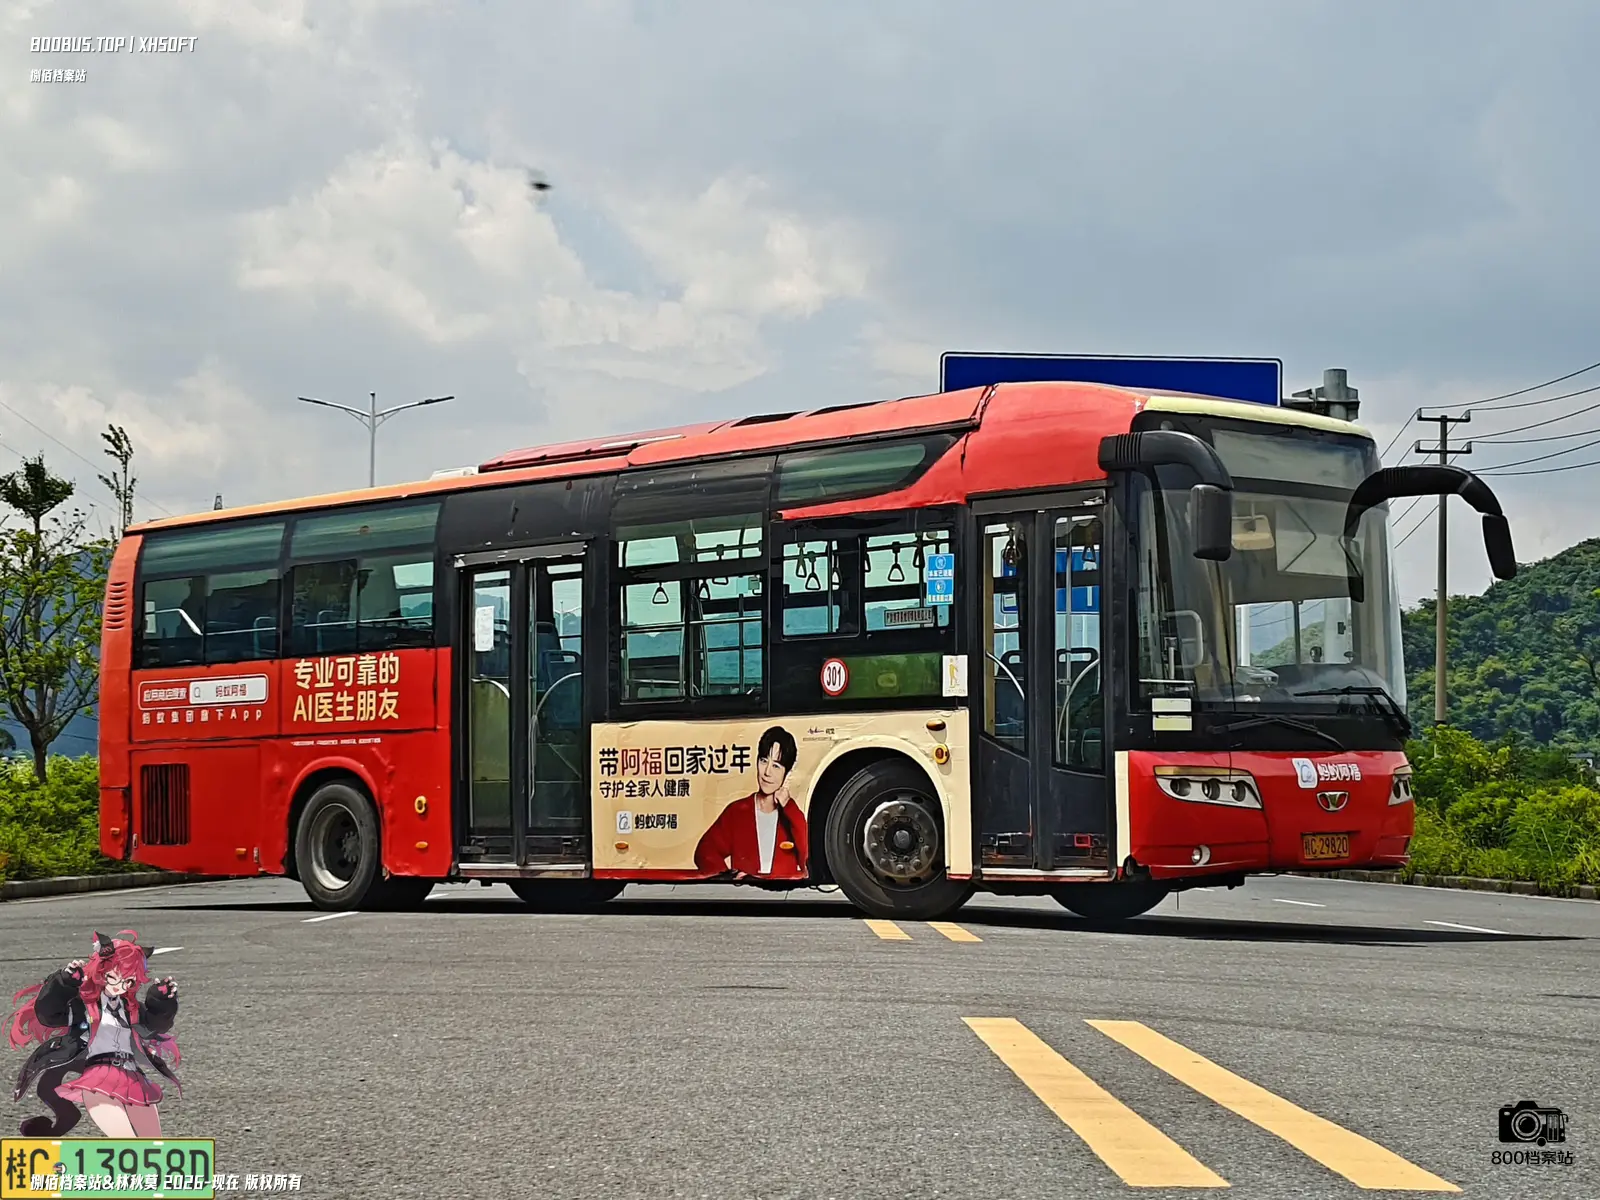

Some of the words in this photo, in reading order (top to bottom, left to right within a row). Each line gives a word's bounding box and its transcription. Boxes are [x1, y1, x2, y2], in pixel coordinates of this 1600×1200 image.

[293, 652, 400, 690] 专业可靠的
[826, 666, 842, 687] 301
[293, 687, 400, 723] AI医生朋友
[598, 743, 752, 777] 带阿福回家过年
[599, 778, 691, 799] 守护全家人健康
[634, 813, 678, 830] 蚂蚁阿福
